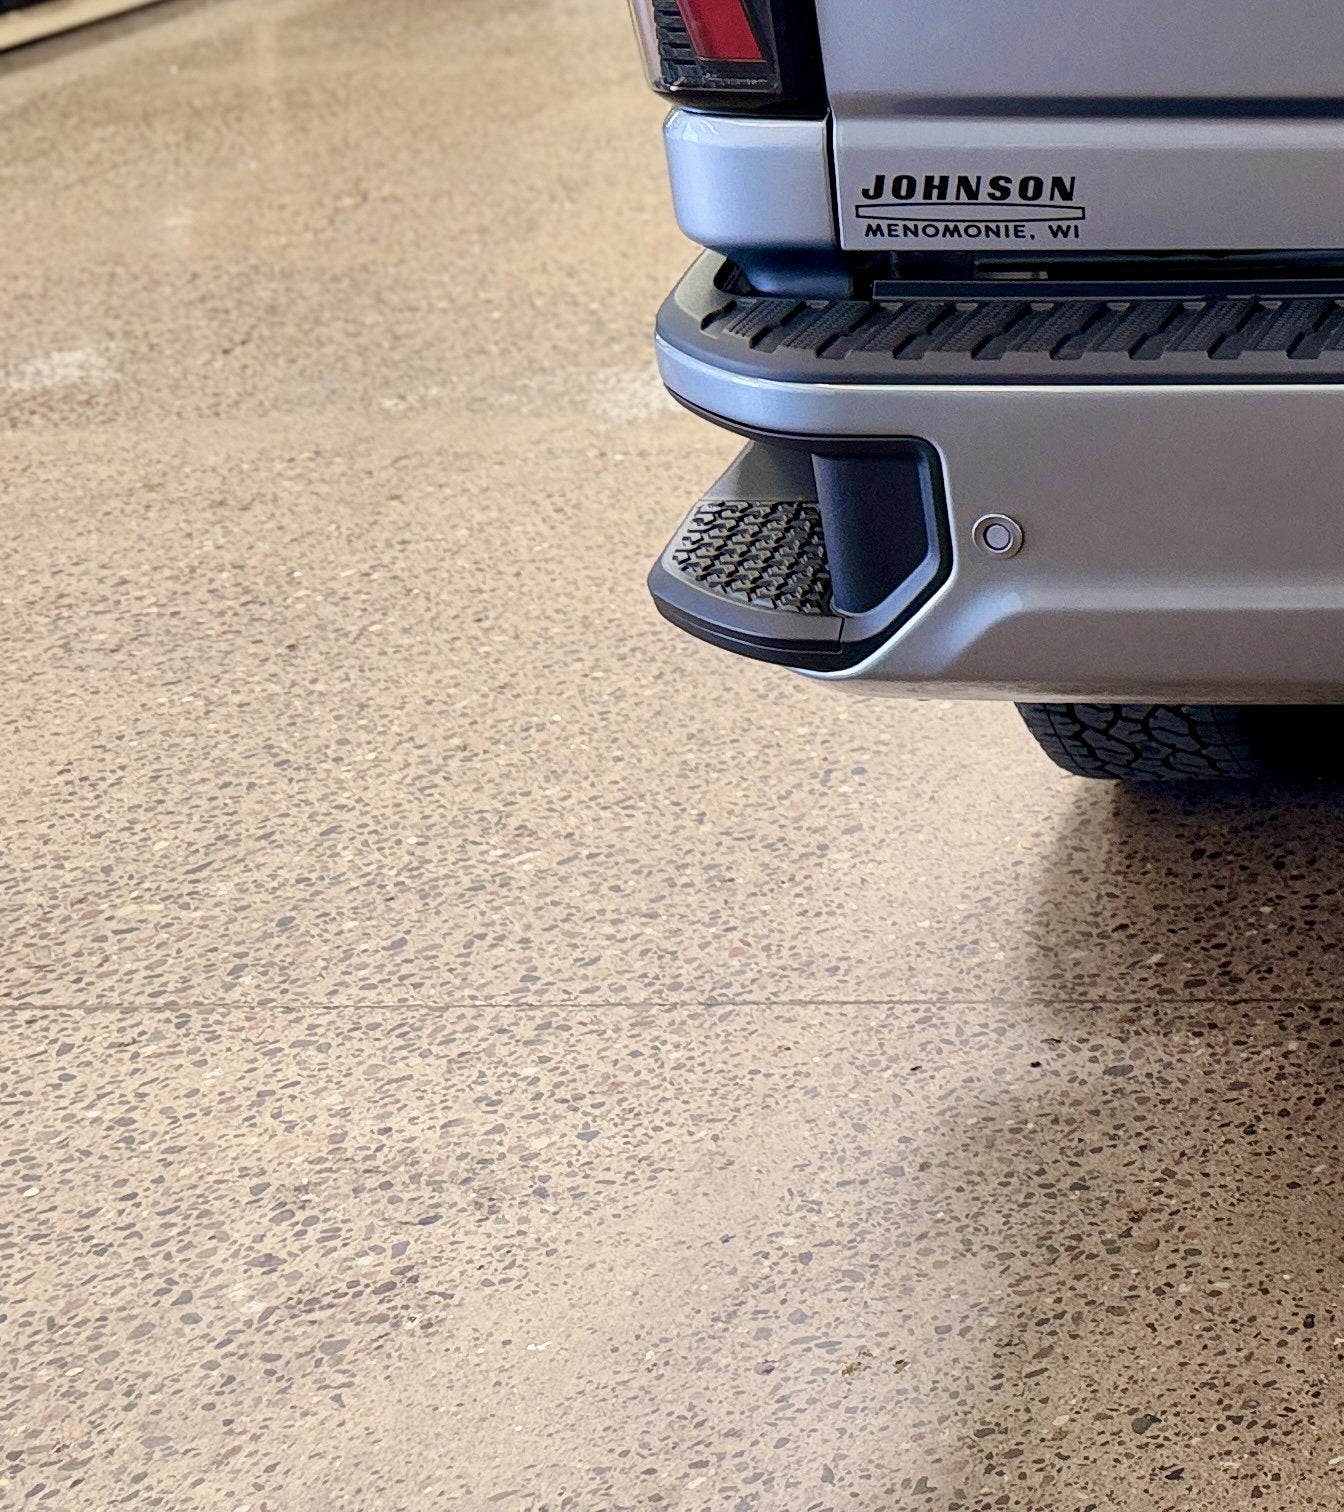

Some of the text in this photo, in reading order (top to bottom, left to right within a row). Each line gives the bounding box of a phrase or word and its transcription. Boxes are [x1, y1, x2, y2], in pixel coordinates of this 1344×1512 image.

[861, 174, 1076, 201] JOHNSON
[865, 223, 1080, 240] MENOMONIE, WI
